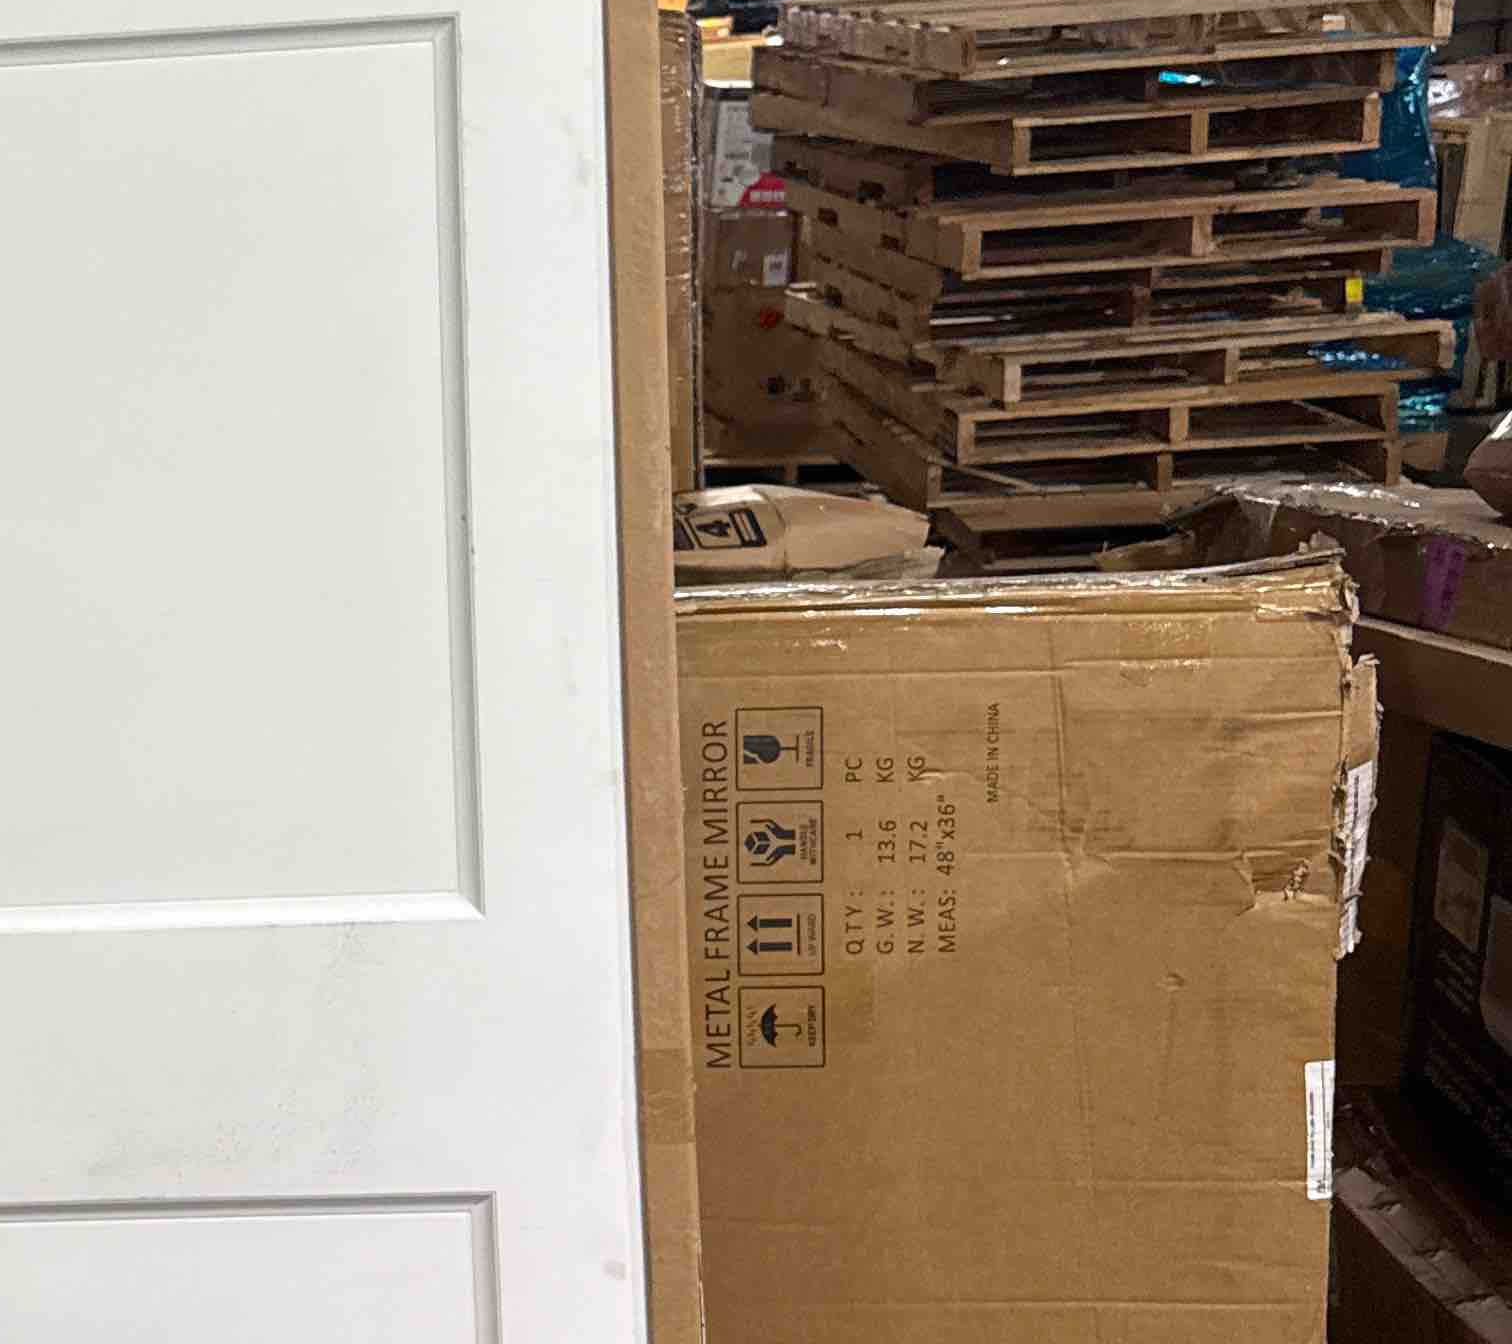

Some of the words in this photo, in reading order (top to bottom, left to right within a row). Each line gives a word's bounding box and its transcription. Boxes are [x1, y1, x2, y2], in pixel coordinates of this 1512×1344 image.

[988, 703, 1000, 743] CHINA
[702, 719, 729, 845] MIRROR
[845, 757, 863, 783] PC
[876, 756, 895, 783] KG
[907, 755, 925, 783] KG
[986, 764, 1000, 803] MADE
[878, 819, 897, 864] 13.6
[909, 820, 928, 864] 17.2
[703, 855, 730, 961] FRAME
[938, 888, 957, 953] MEAS:
[705, 968, 731, 1069] METAL
